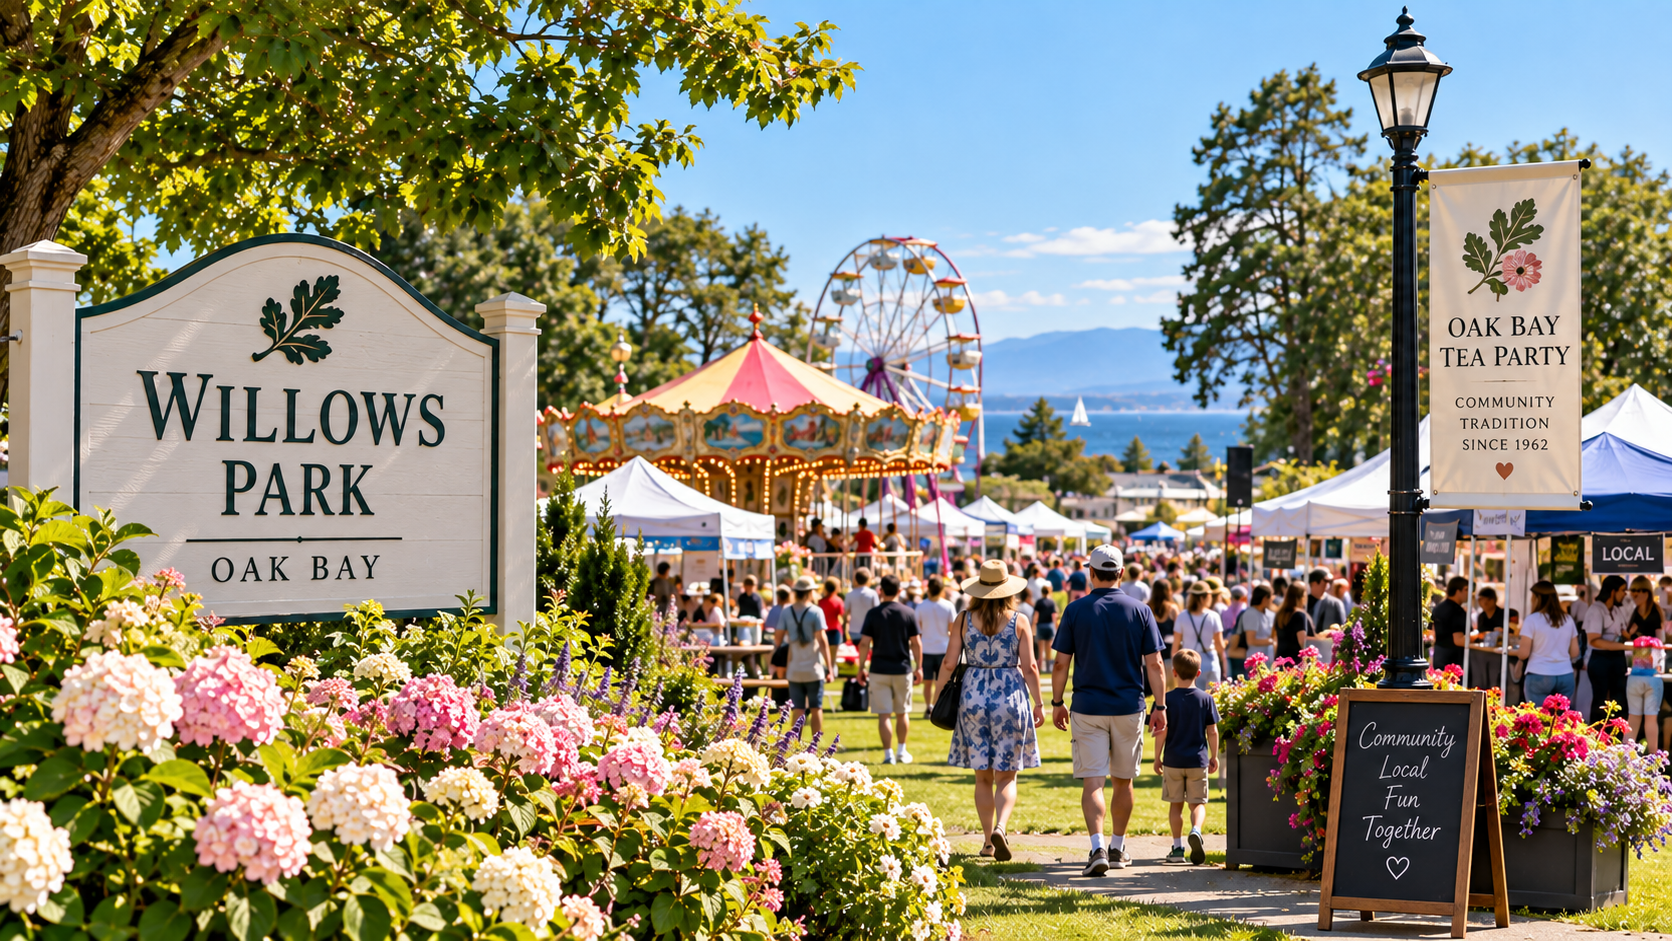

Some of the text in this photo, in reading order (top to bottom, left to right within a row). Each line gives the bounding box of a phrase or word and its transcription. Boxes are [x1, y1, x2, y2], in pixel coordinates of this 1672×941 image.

[1448, 315, 1561, 338] OAK BAY
[1439, 345, 1571, 368] TEA PARTY
[136, 369, 446, 448] WILLOWS
[1455, 396, 1556, 409] COMMUNITY
[1459, 417, 1549, 430] TRADITION
[1462, 438, 1549, 451] SINCE 1962
[220, 459, 375, 517] PARK
[1602, 546, 1655, 562] LOCAL
[211, 555, 381, 583] OAK BAY
[1358, 721, 1457, 759] Community
[1378, 754, 1430, 780] Local
[1384, 784, 1421, 810] Fun
[1362, 815, 1442, 849] Together
